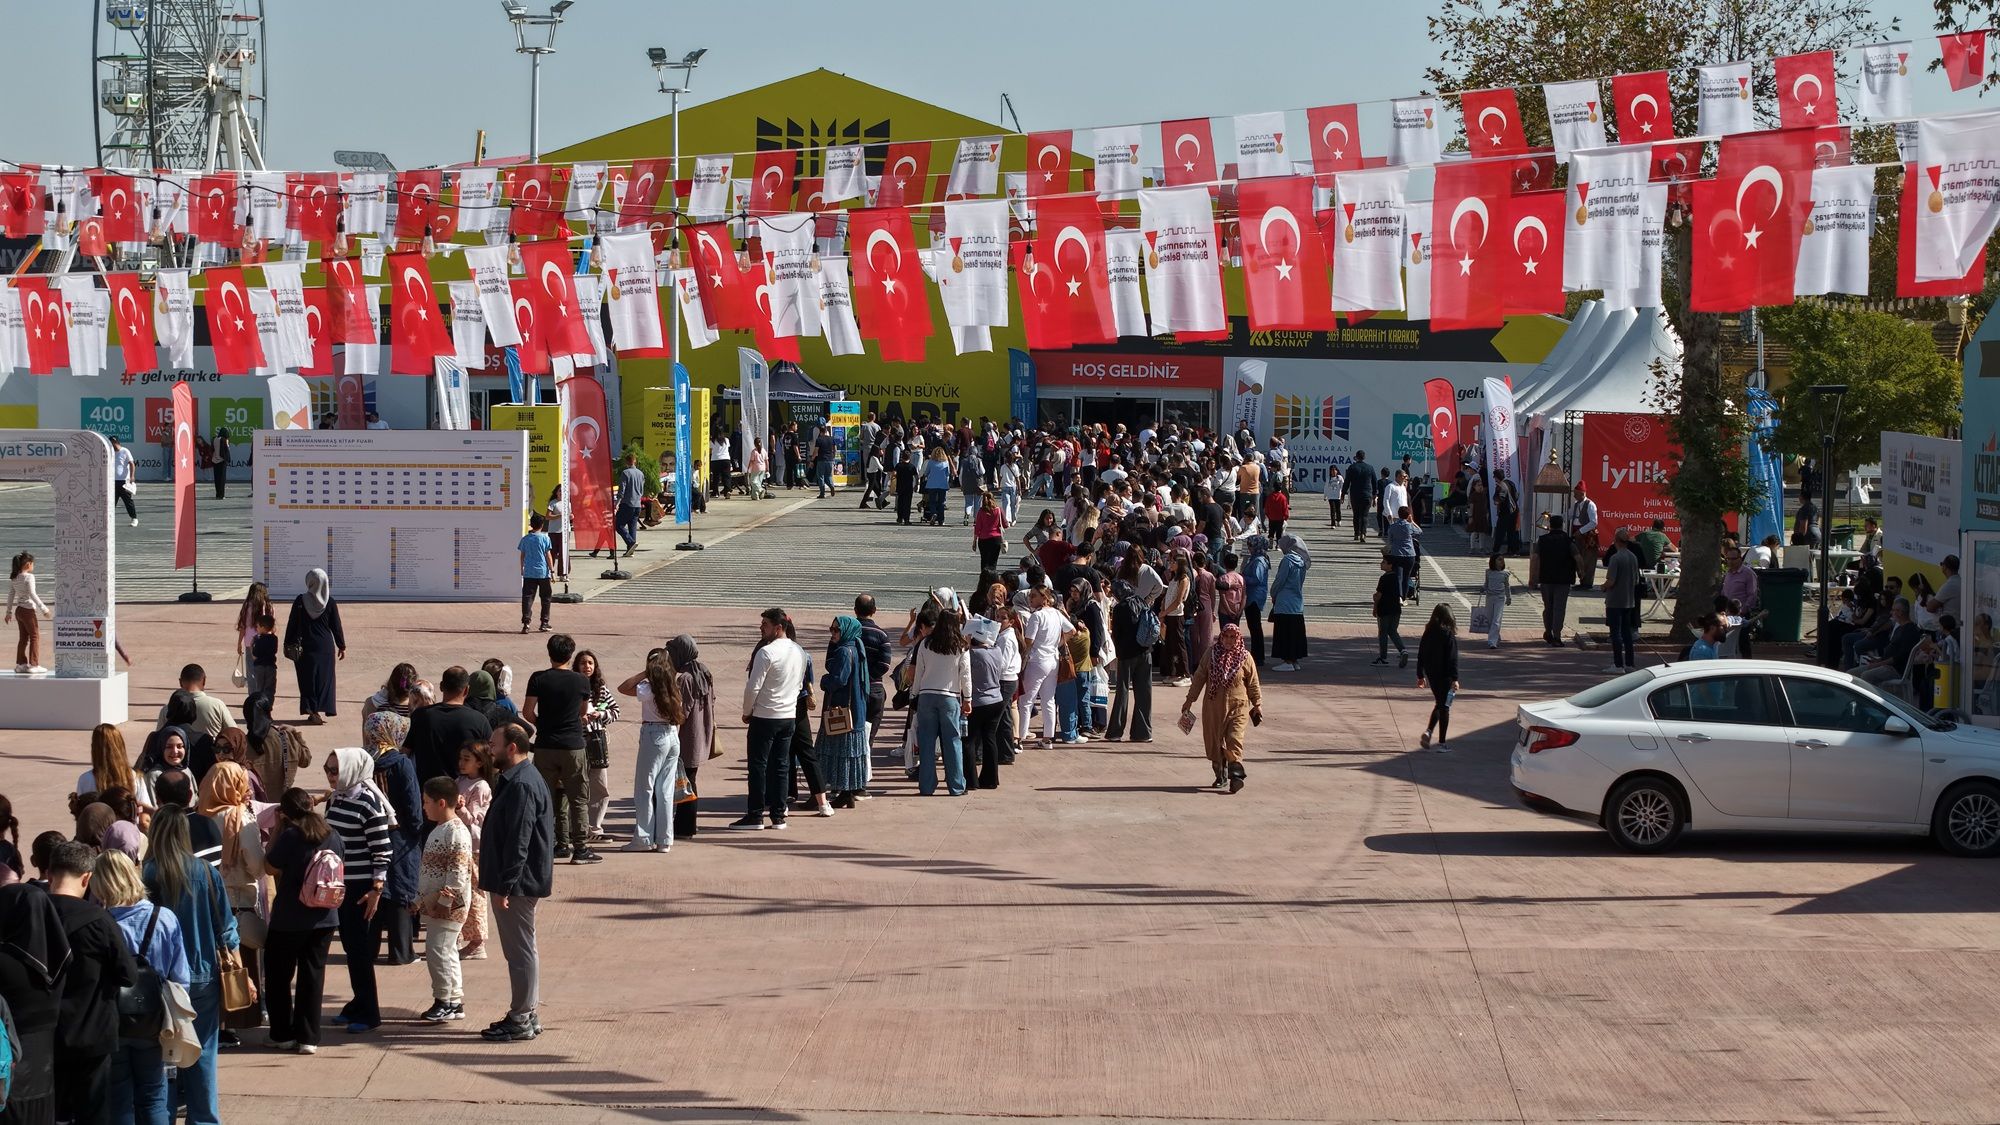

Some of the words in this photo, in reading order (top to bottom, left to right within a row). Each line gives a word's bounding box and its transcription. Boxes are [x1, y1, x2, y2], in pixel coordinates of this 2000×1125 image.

[1274, 339, 1309, 347] SANAT
[1388, 329, 1420, 345] KARAKOÇ
[1072, 363, 1106, 380] HOŞ
[1109, 362, 1180, 379] GELDİNİZ
[893, 385, 910, 397] EN
[915, 383, 960, 398] BÜYÜK
[1457, 387, 1479, 402] gel
[90, 406, 125, 422] 400
[225, 407, 248, 423] 50
[118, 424, 130, 433] ve
[141, 459, 162, 468] 2026
[1602, 454, 1669, 489] İyilik
[1643, 496, 1662, 507] İyilik
[1602, 511, 1642, 520] Türkiyenin
